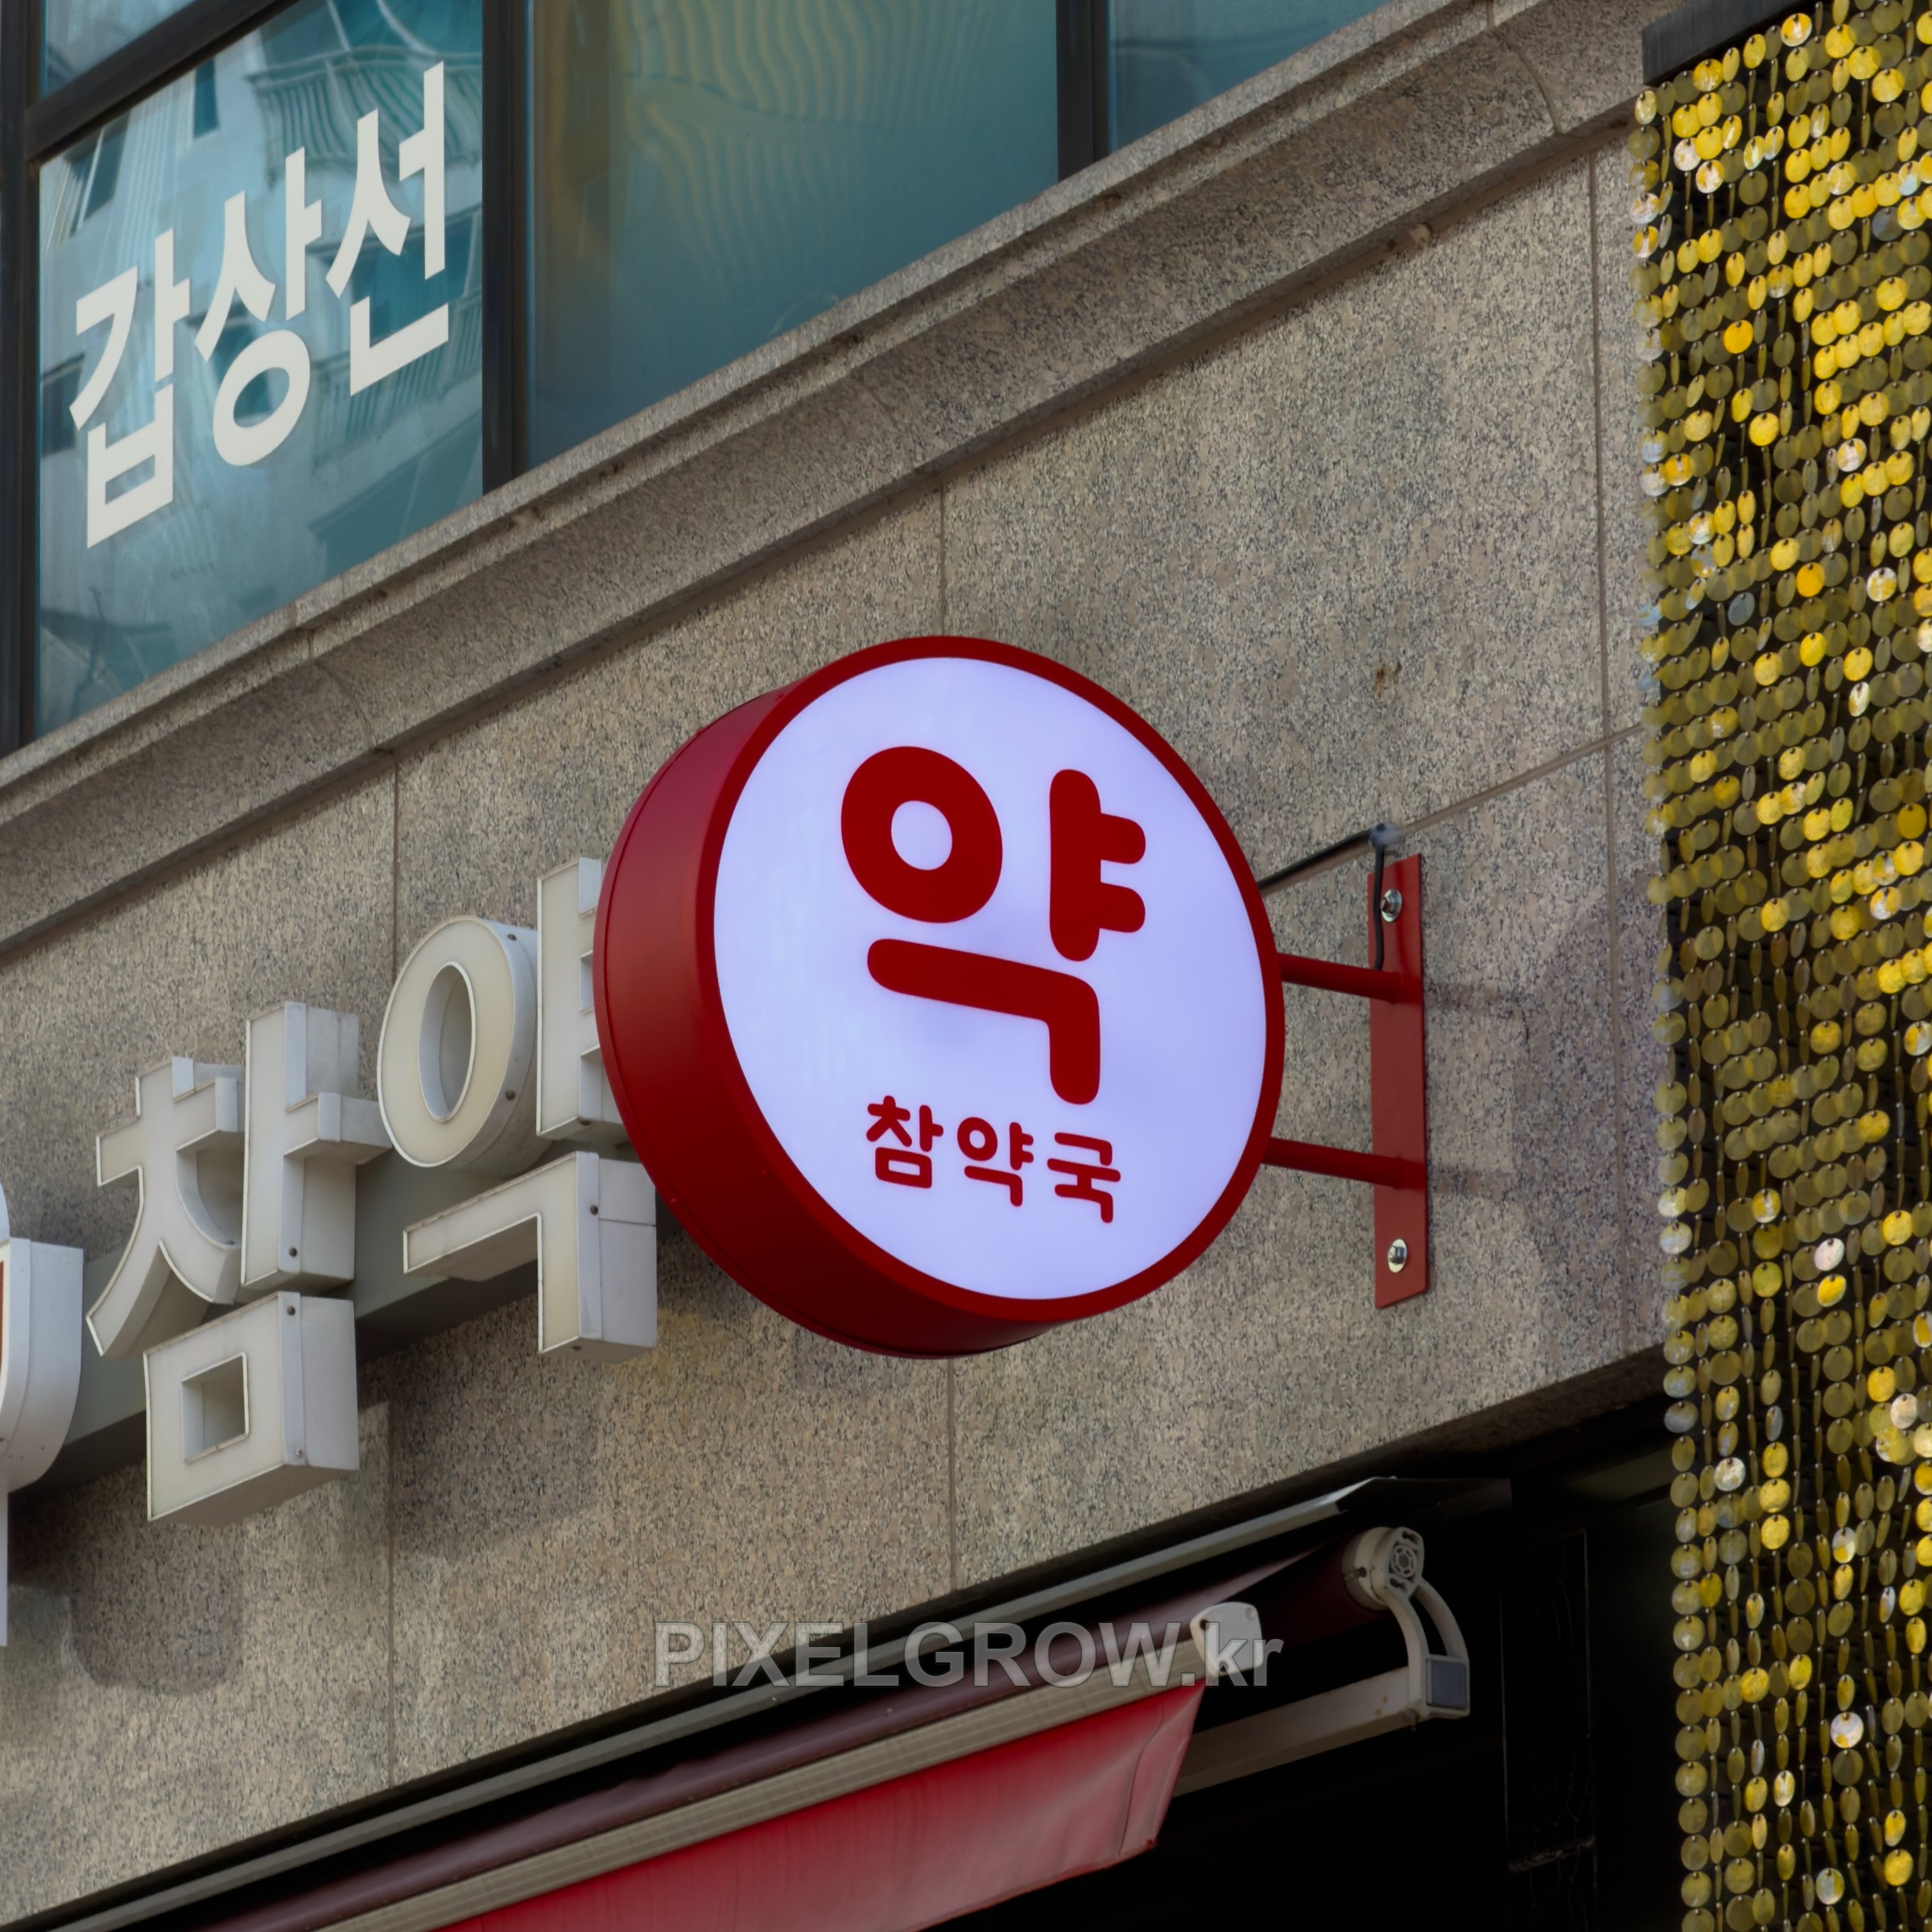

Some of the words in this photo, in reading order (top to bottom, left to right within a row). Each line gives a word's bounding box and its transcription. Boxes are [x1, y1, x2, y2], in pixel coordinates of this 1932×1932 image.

[69, 60, 448, 548] 갑상선
[840, 745, 1146, 1105] 약
[865, 1095, 1121, 1224] 참약국
